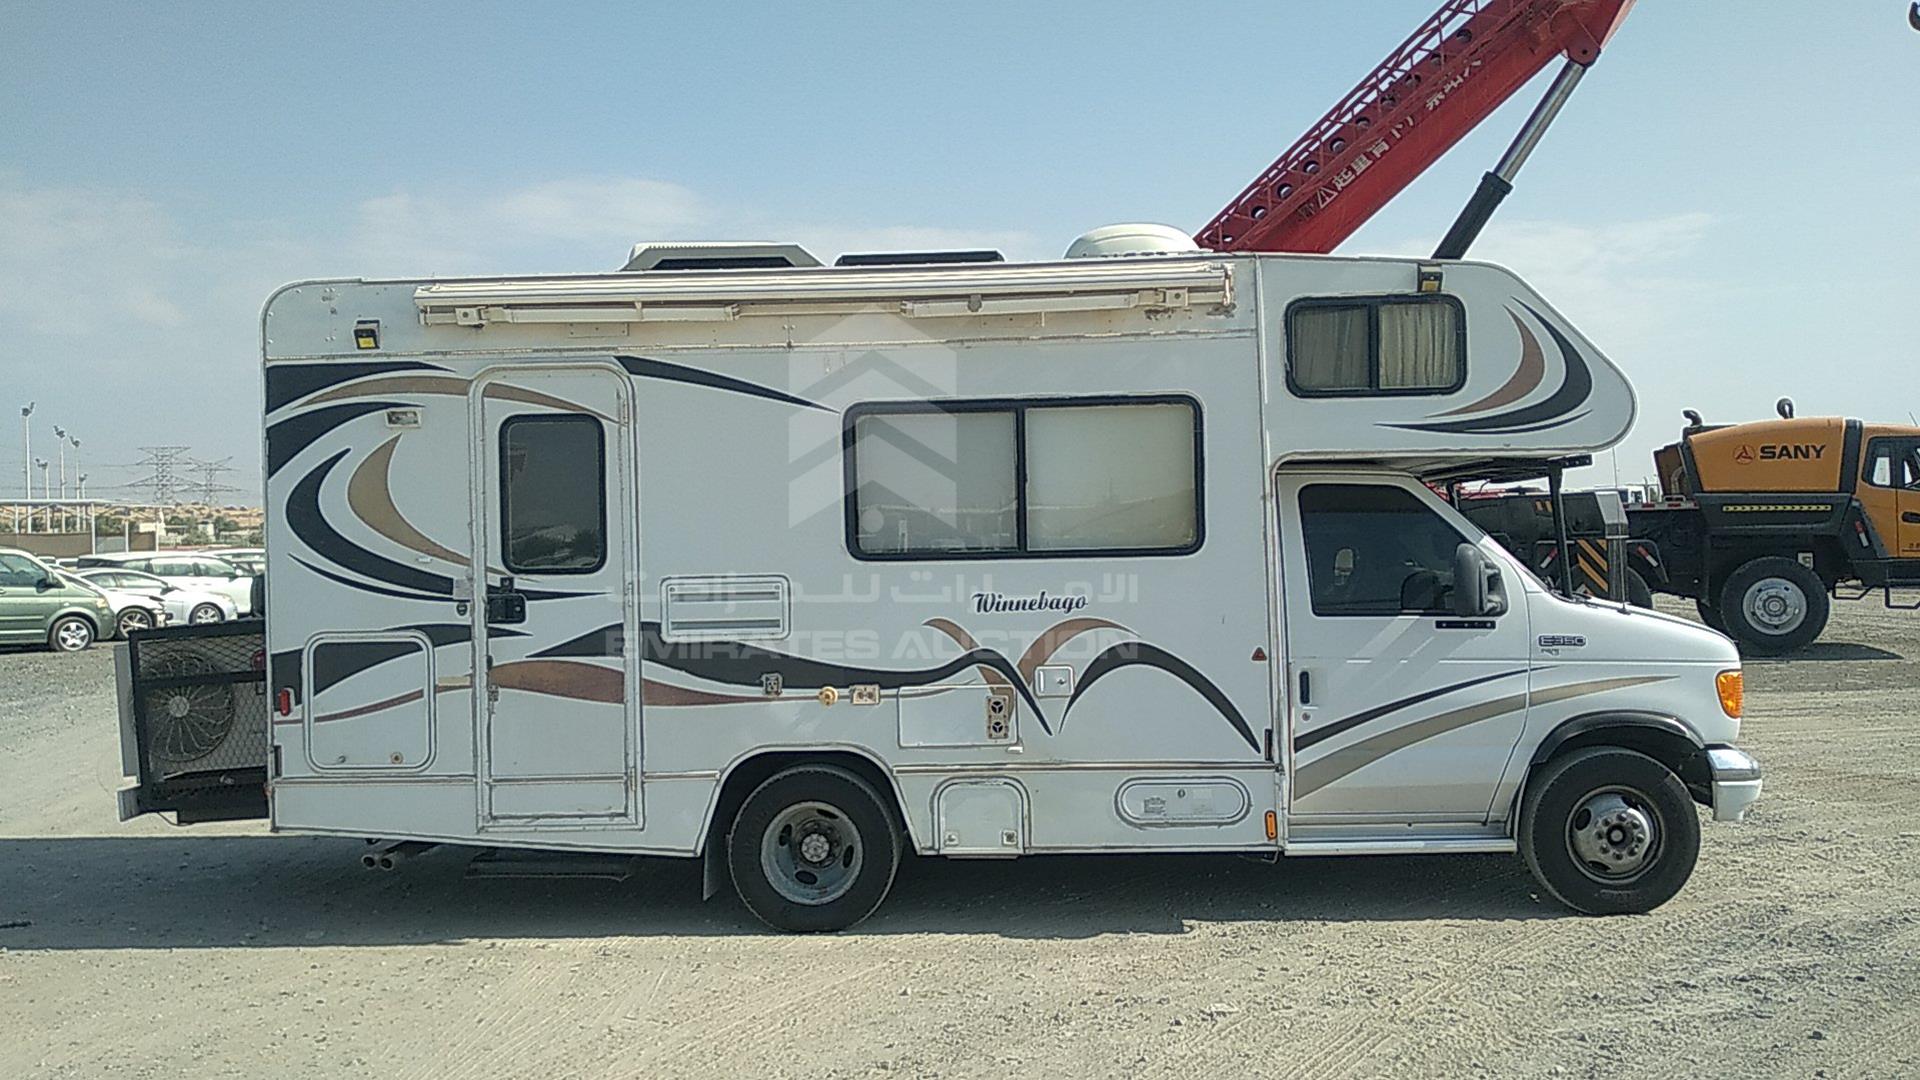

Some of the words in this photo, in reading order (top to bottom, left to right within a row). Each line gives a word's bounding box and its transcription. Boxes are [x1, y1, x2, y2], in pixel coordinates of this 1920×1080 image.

[1759, 444, 1827, 460] SANY
[972, 591, 1089, 614] Winnebago
[1539, 635, 1586, 647] E350
